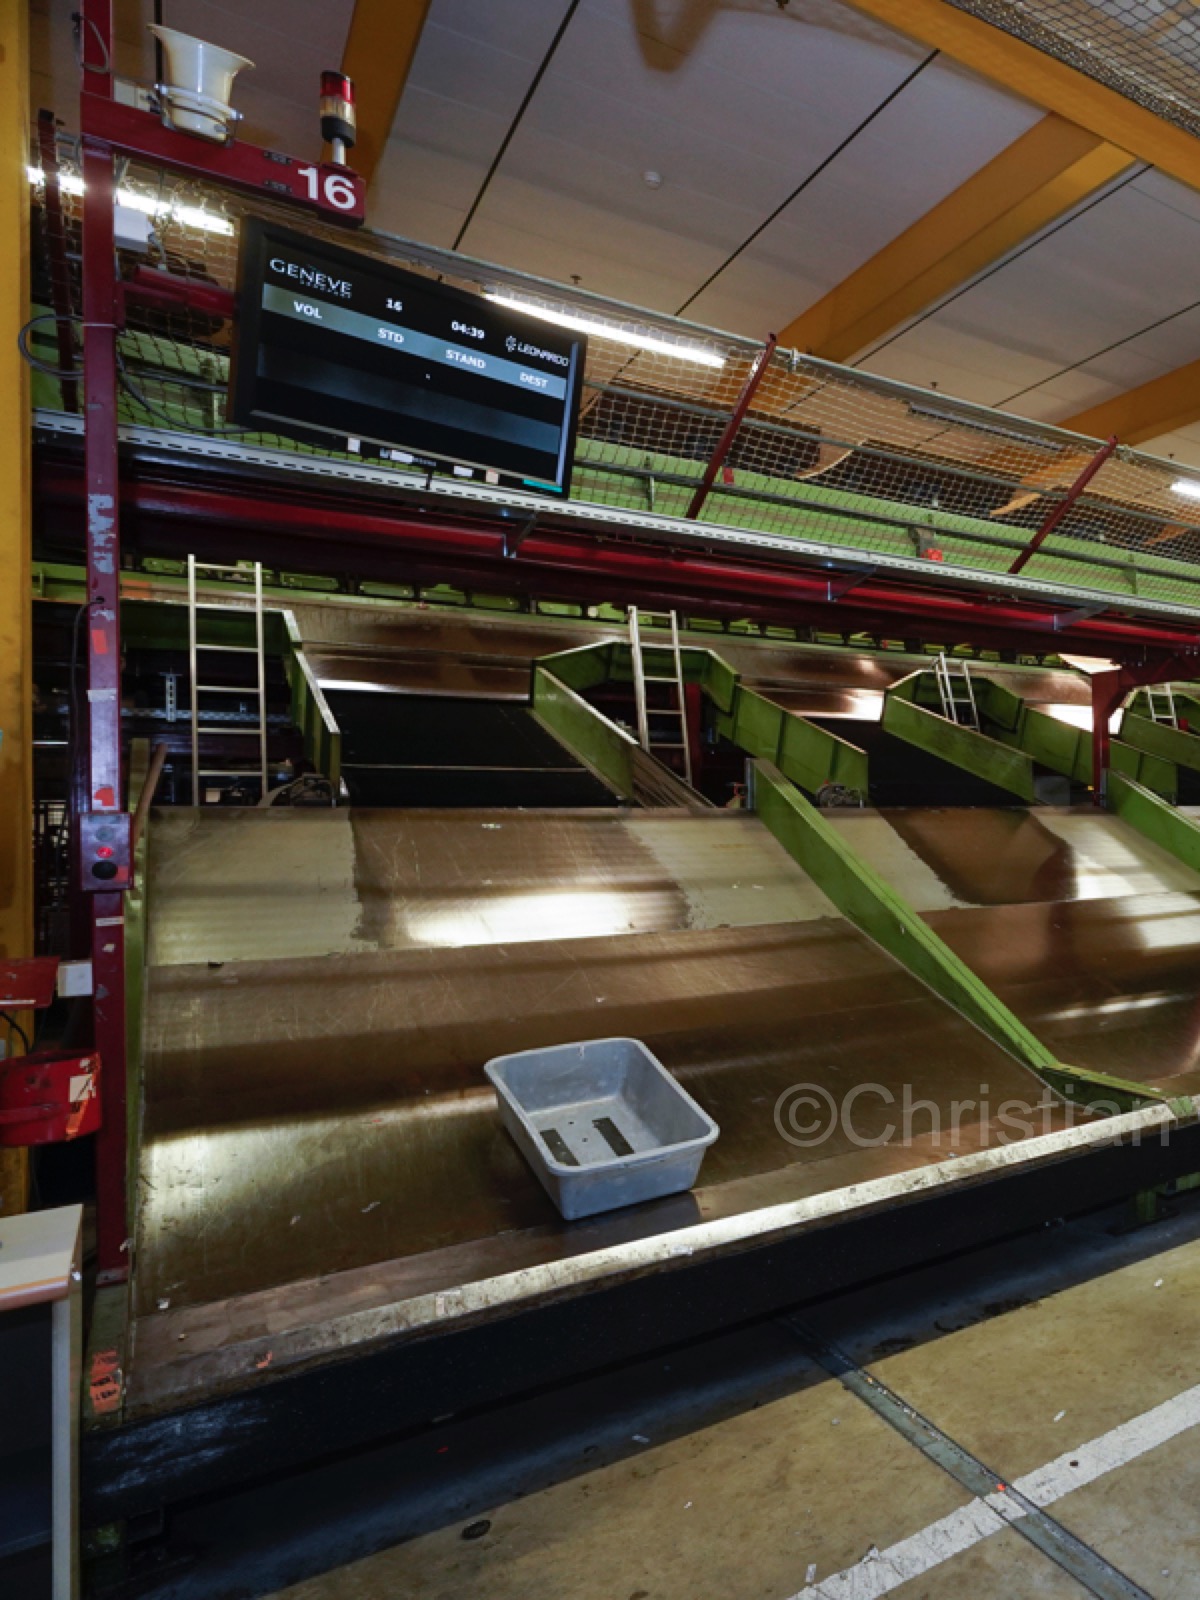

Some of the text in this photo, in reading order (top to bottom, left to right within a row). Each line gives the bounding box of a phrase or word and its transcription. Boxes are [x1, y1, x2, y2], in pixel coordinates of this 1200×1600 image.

[298, 166, 356, 209] 16
[386, 298, 402, 311] 16
[293, 301, 548, 389] VOL STD STAND DEST
